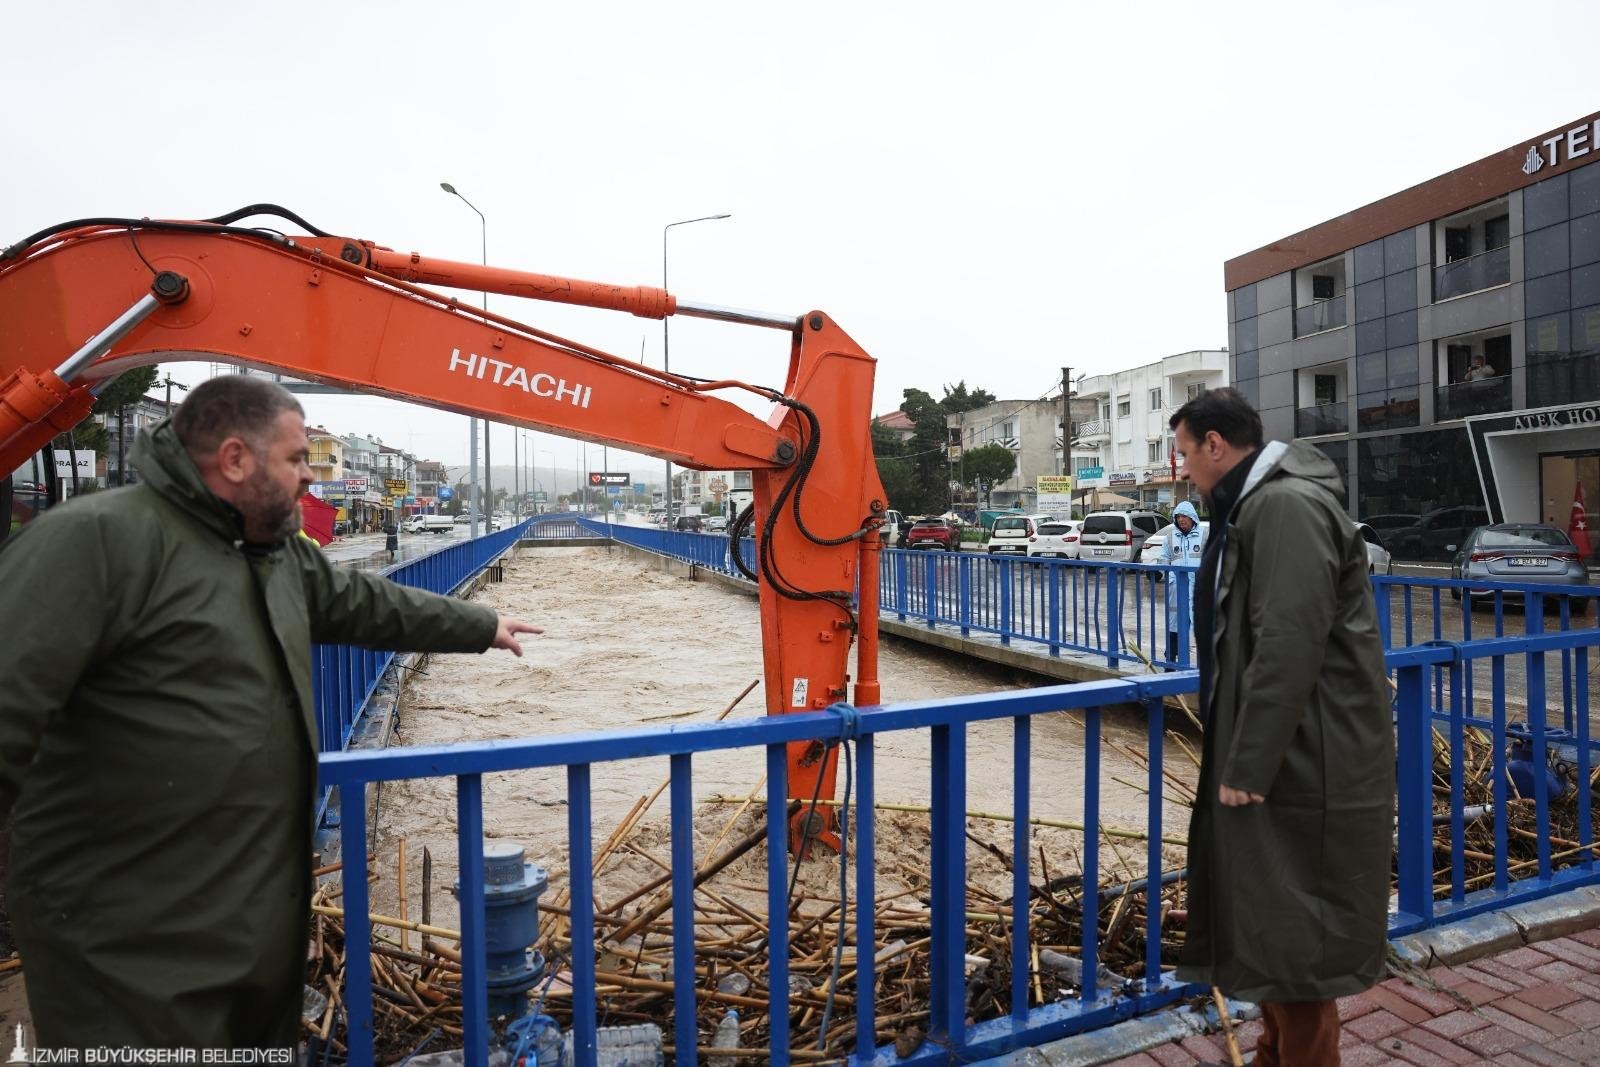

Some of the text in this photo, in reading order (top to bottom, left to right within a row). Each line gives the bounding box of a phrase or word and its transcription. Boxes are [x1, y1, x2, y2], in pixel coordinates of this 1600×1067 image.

[1543, 119, 1600, 166] TE
[448, 348, 592, 408] HITACHI
[1514, 406, 1600, 430] ATEK HO
